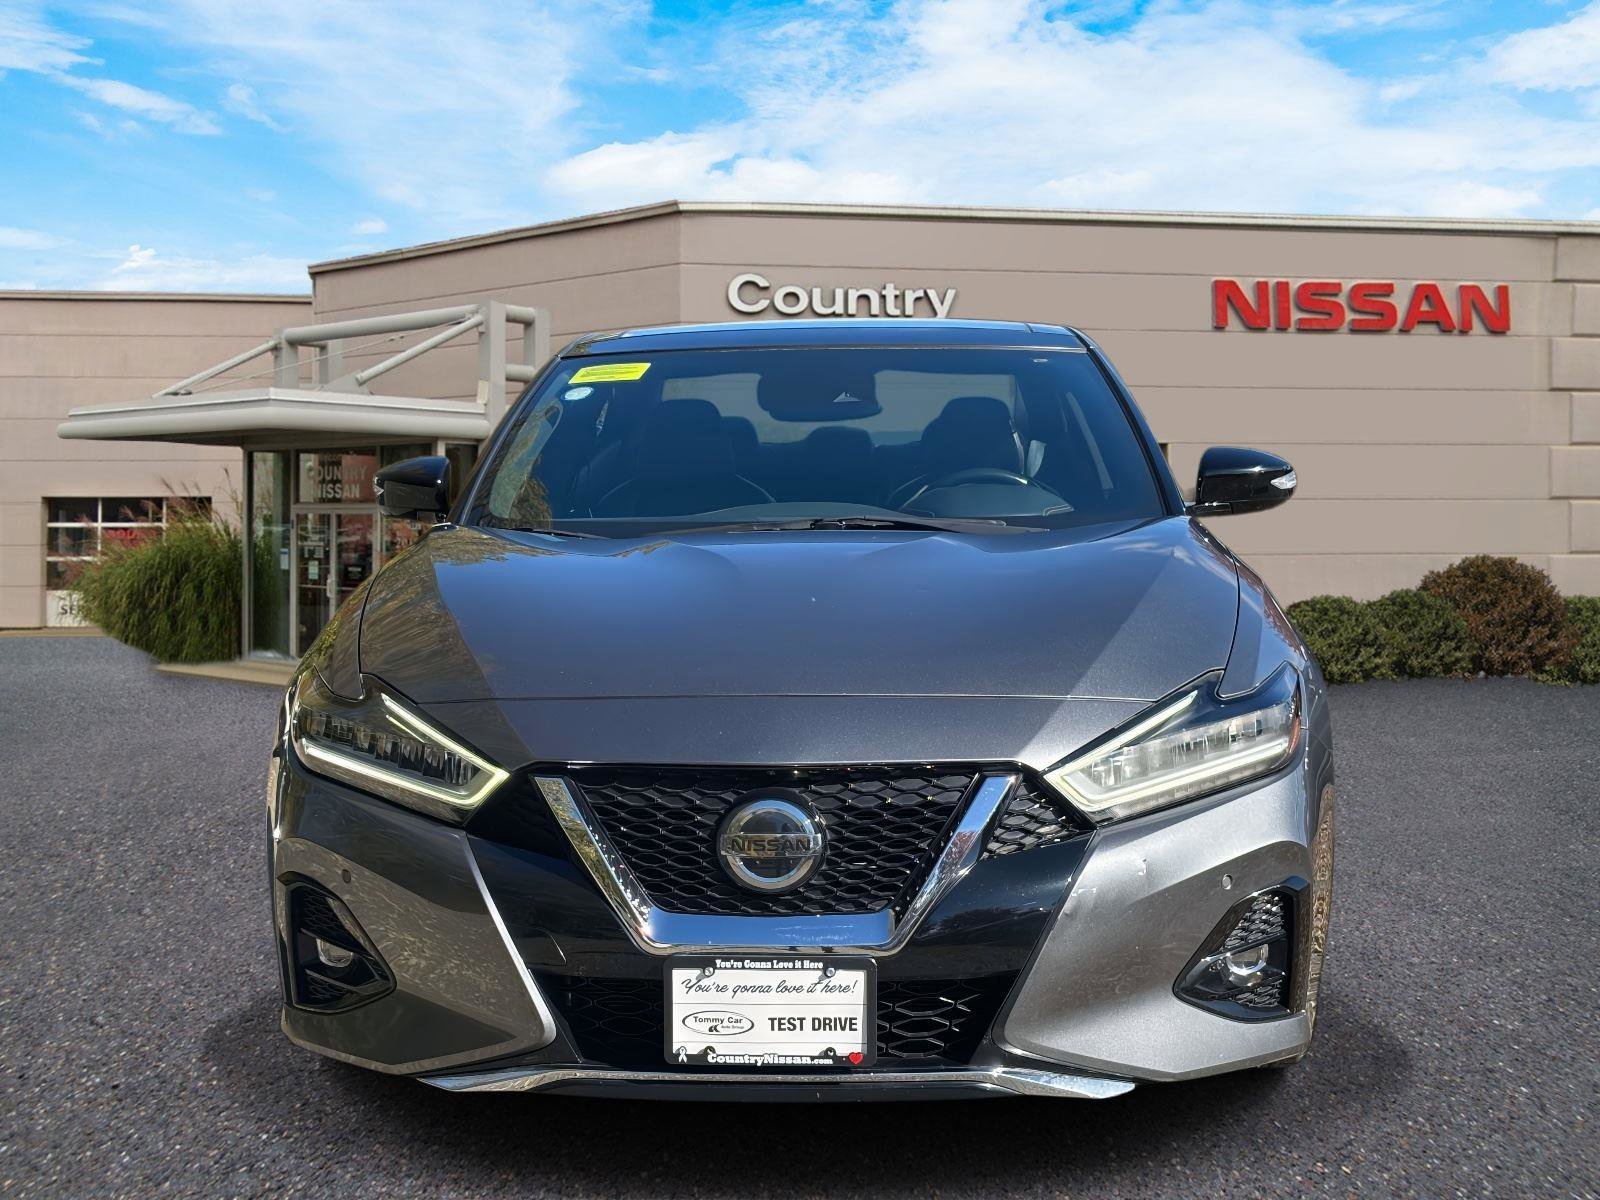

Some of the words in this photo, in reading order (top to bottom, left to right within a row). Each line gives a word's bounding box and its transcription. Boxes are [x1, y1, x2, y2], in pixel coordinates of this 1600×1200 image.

[727, 273, 956, 318] Country
[1212, 277, 1511, 333] NISSAN
[312, 483, 360, 498] NISSAN
[731, 838, 811, 853] NISSAN
[715, 959, 743, 969] You're
[743, 959, 772, 969] Gonna
[772, 960, 794, 969] Love
[794, 960, 802, 969] it
[803, 960, 824, 969] Here
[681, 978, 729, 995] You're
[731, 984, 773, 999] gonna
[775, 979, 805, 994] love
[806, 980, 824, 994] it
[820, 980, 858, 994] here!
[693, 1015, 725, 1025] Tommy
[727, 1016, 744, 1024] Car
[768, 1017, 806, 1032] TEST
[811, 1017, 858, 1032] DRIVE
[707, 1053, 834, 1067] CountryNissan.com
